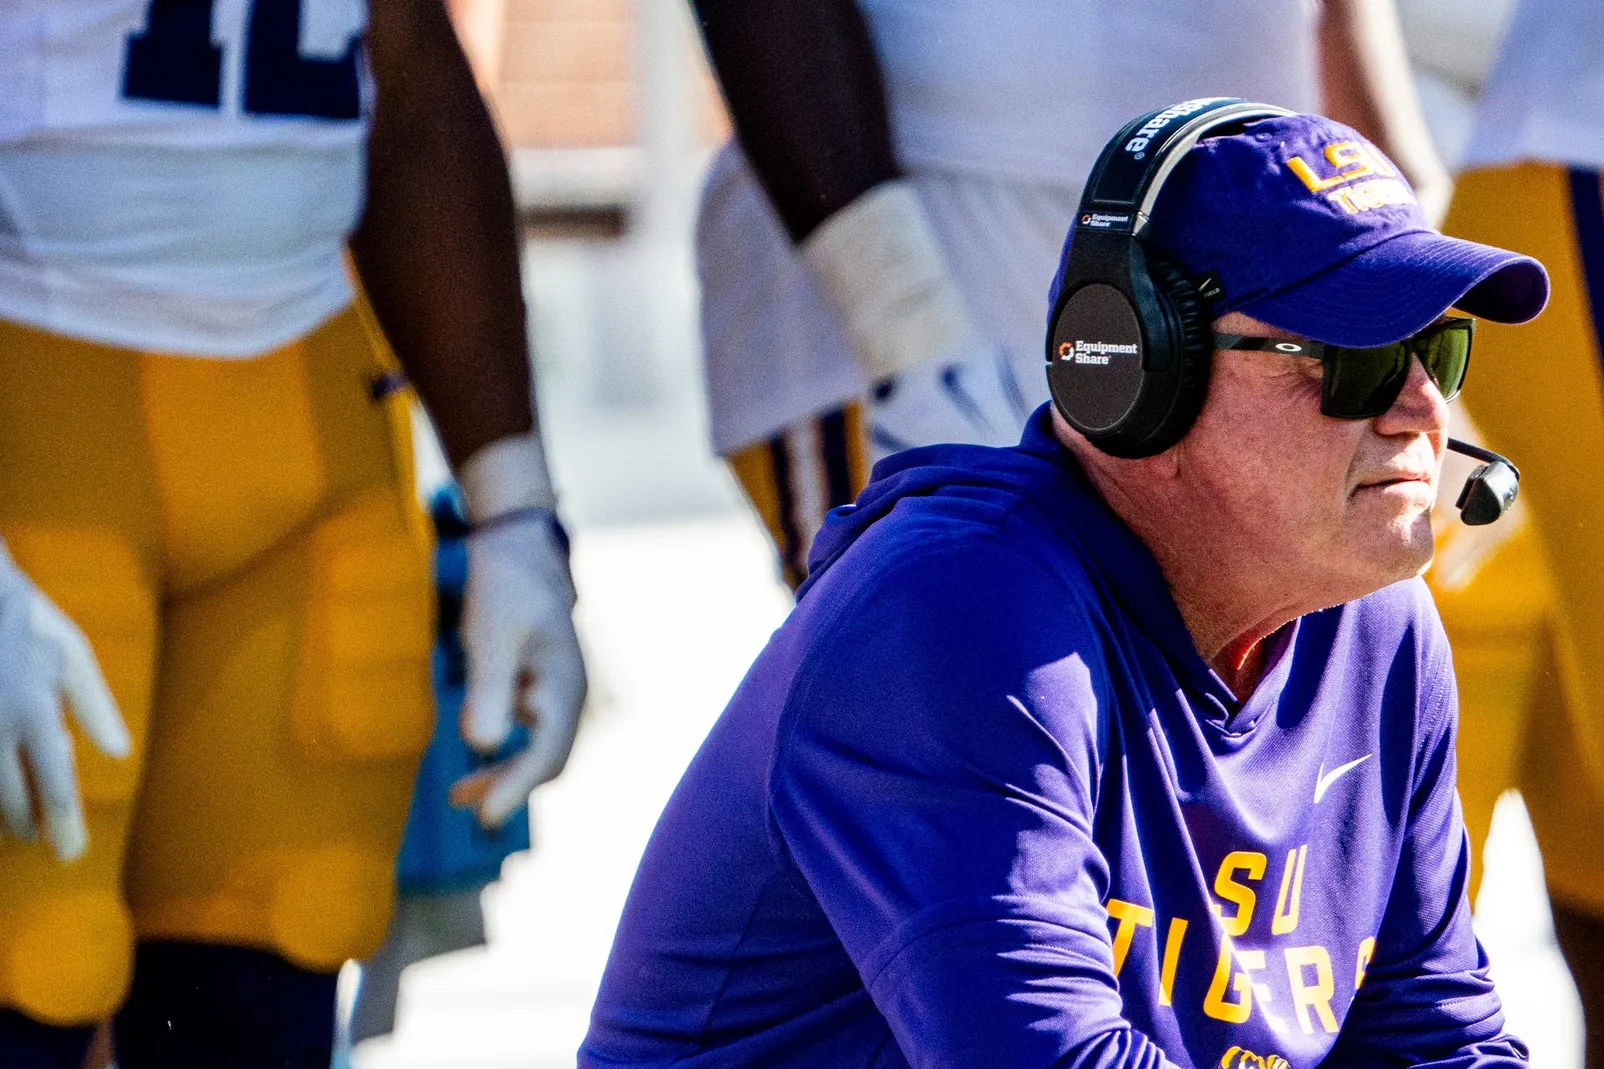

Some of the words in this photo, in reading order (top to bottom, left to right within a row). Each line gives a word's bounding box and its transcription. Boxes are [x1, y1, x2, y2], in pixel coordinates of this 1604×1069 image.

[1075, 340, 1138, 354] Equipment
[1074, 352, 1110, 365] Share
[1212, 844, 1308, 937] SU
